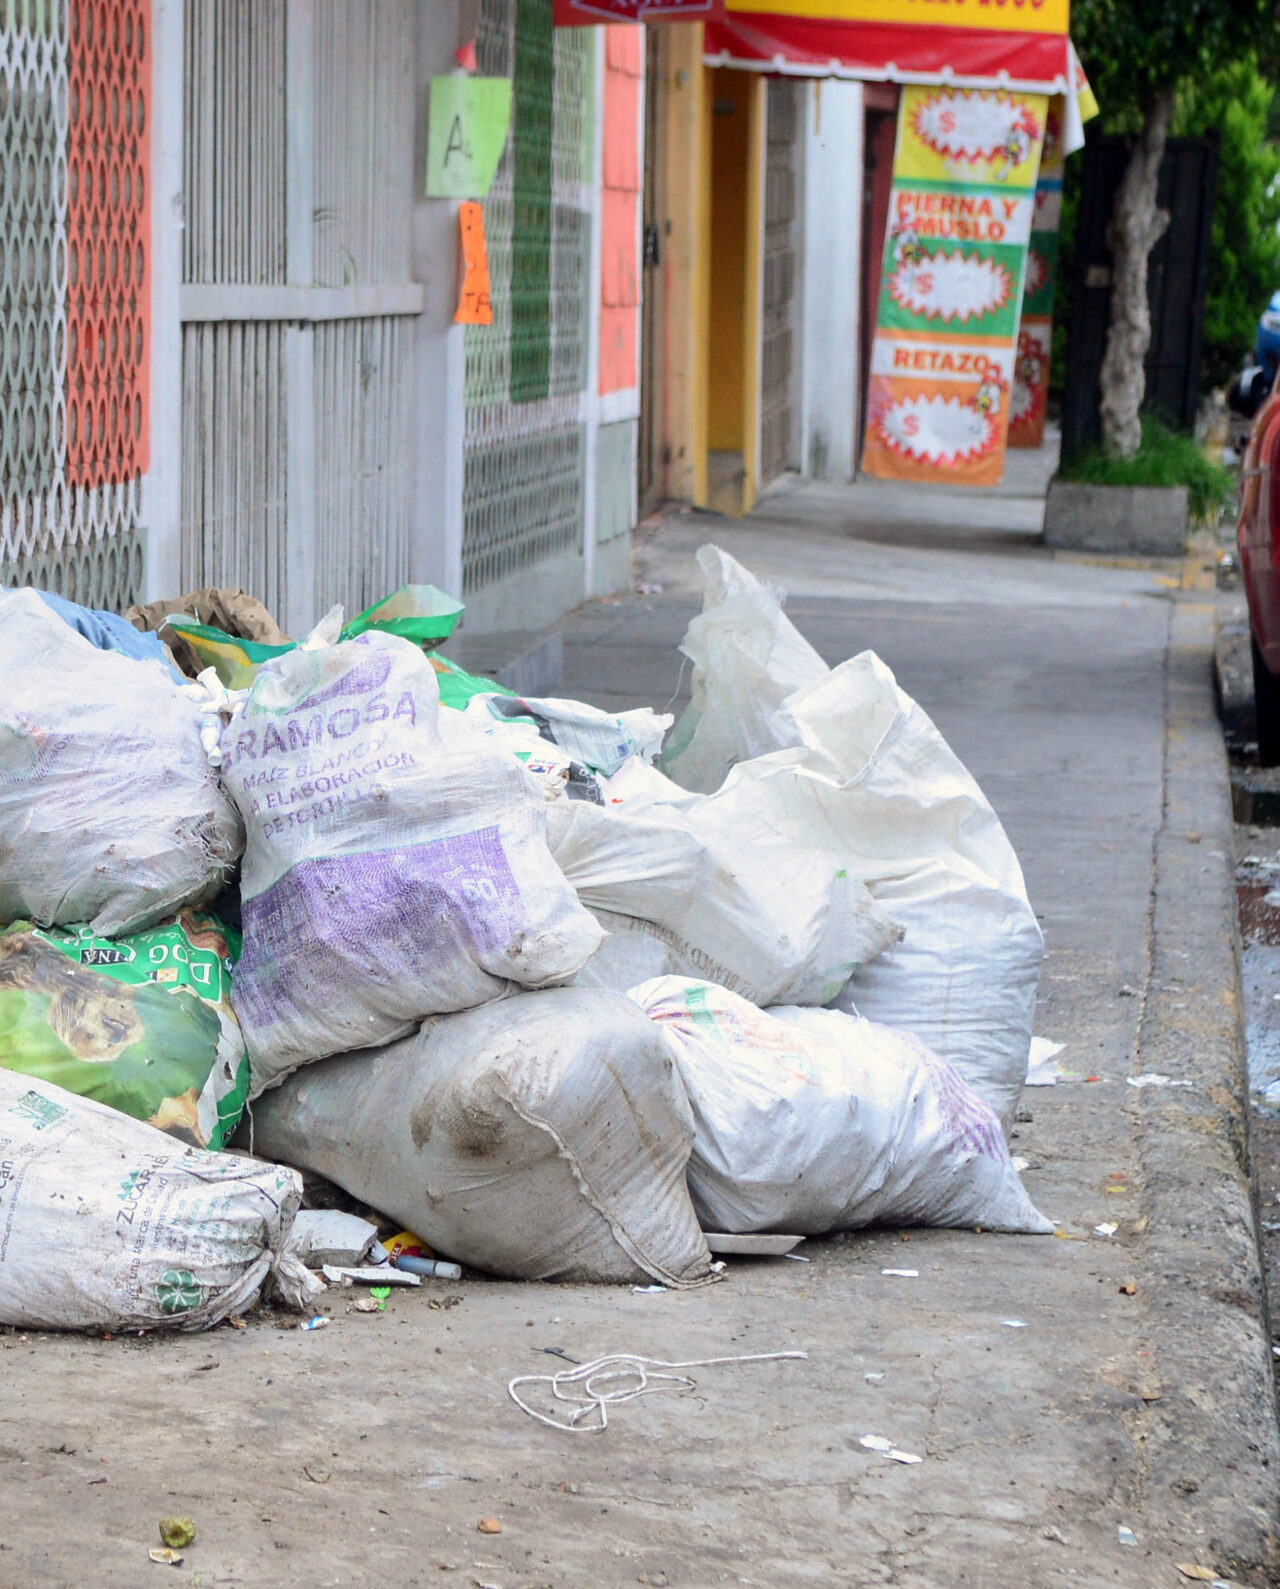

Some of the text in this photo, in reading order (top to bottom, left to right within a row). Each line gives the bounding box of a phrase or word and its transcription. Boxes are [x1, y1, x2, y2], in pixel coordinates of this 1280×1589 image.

[896, 190, 1018, 221] PIERNA Y
[917, 215, 1007, 243] MUSLO
[892, 347, 992, 374] RETAZO
[148, 943, 213, 985] DOG
